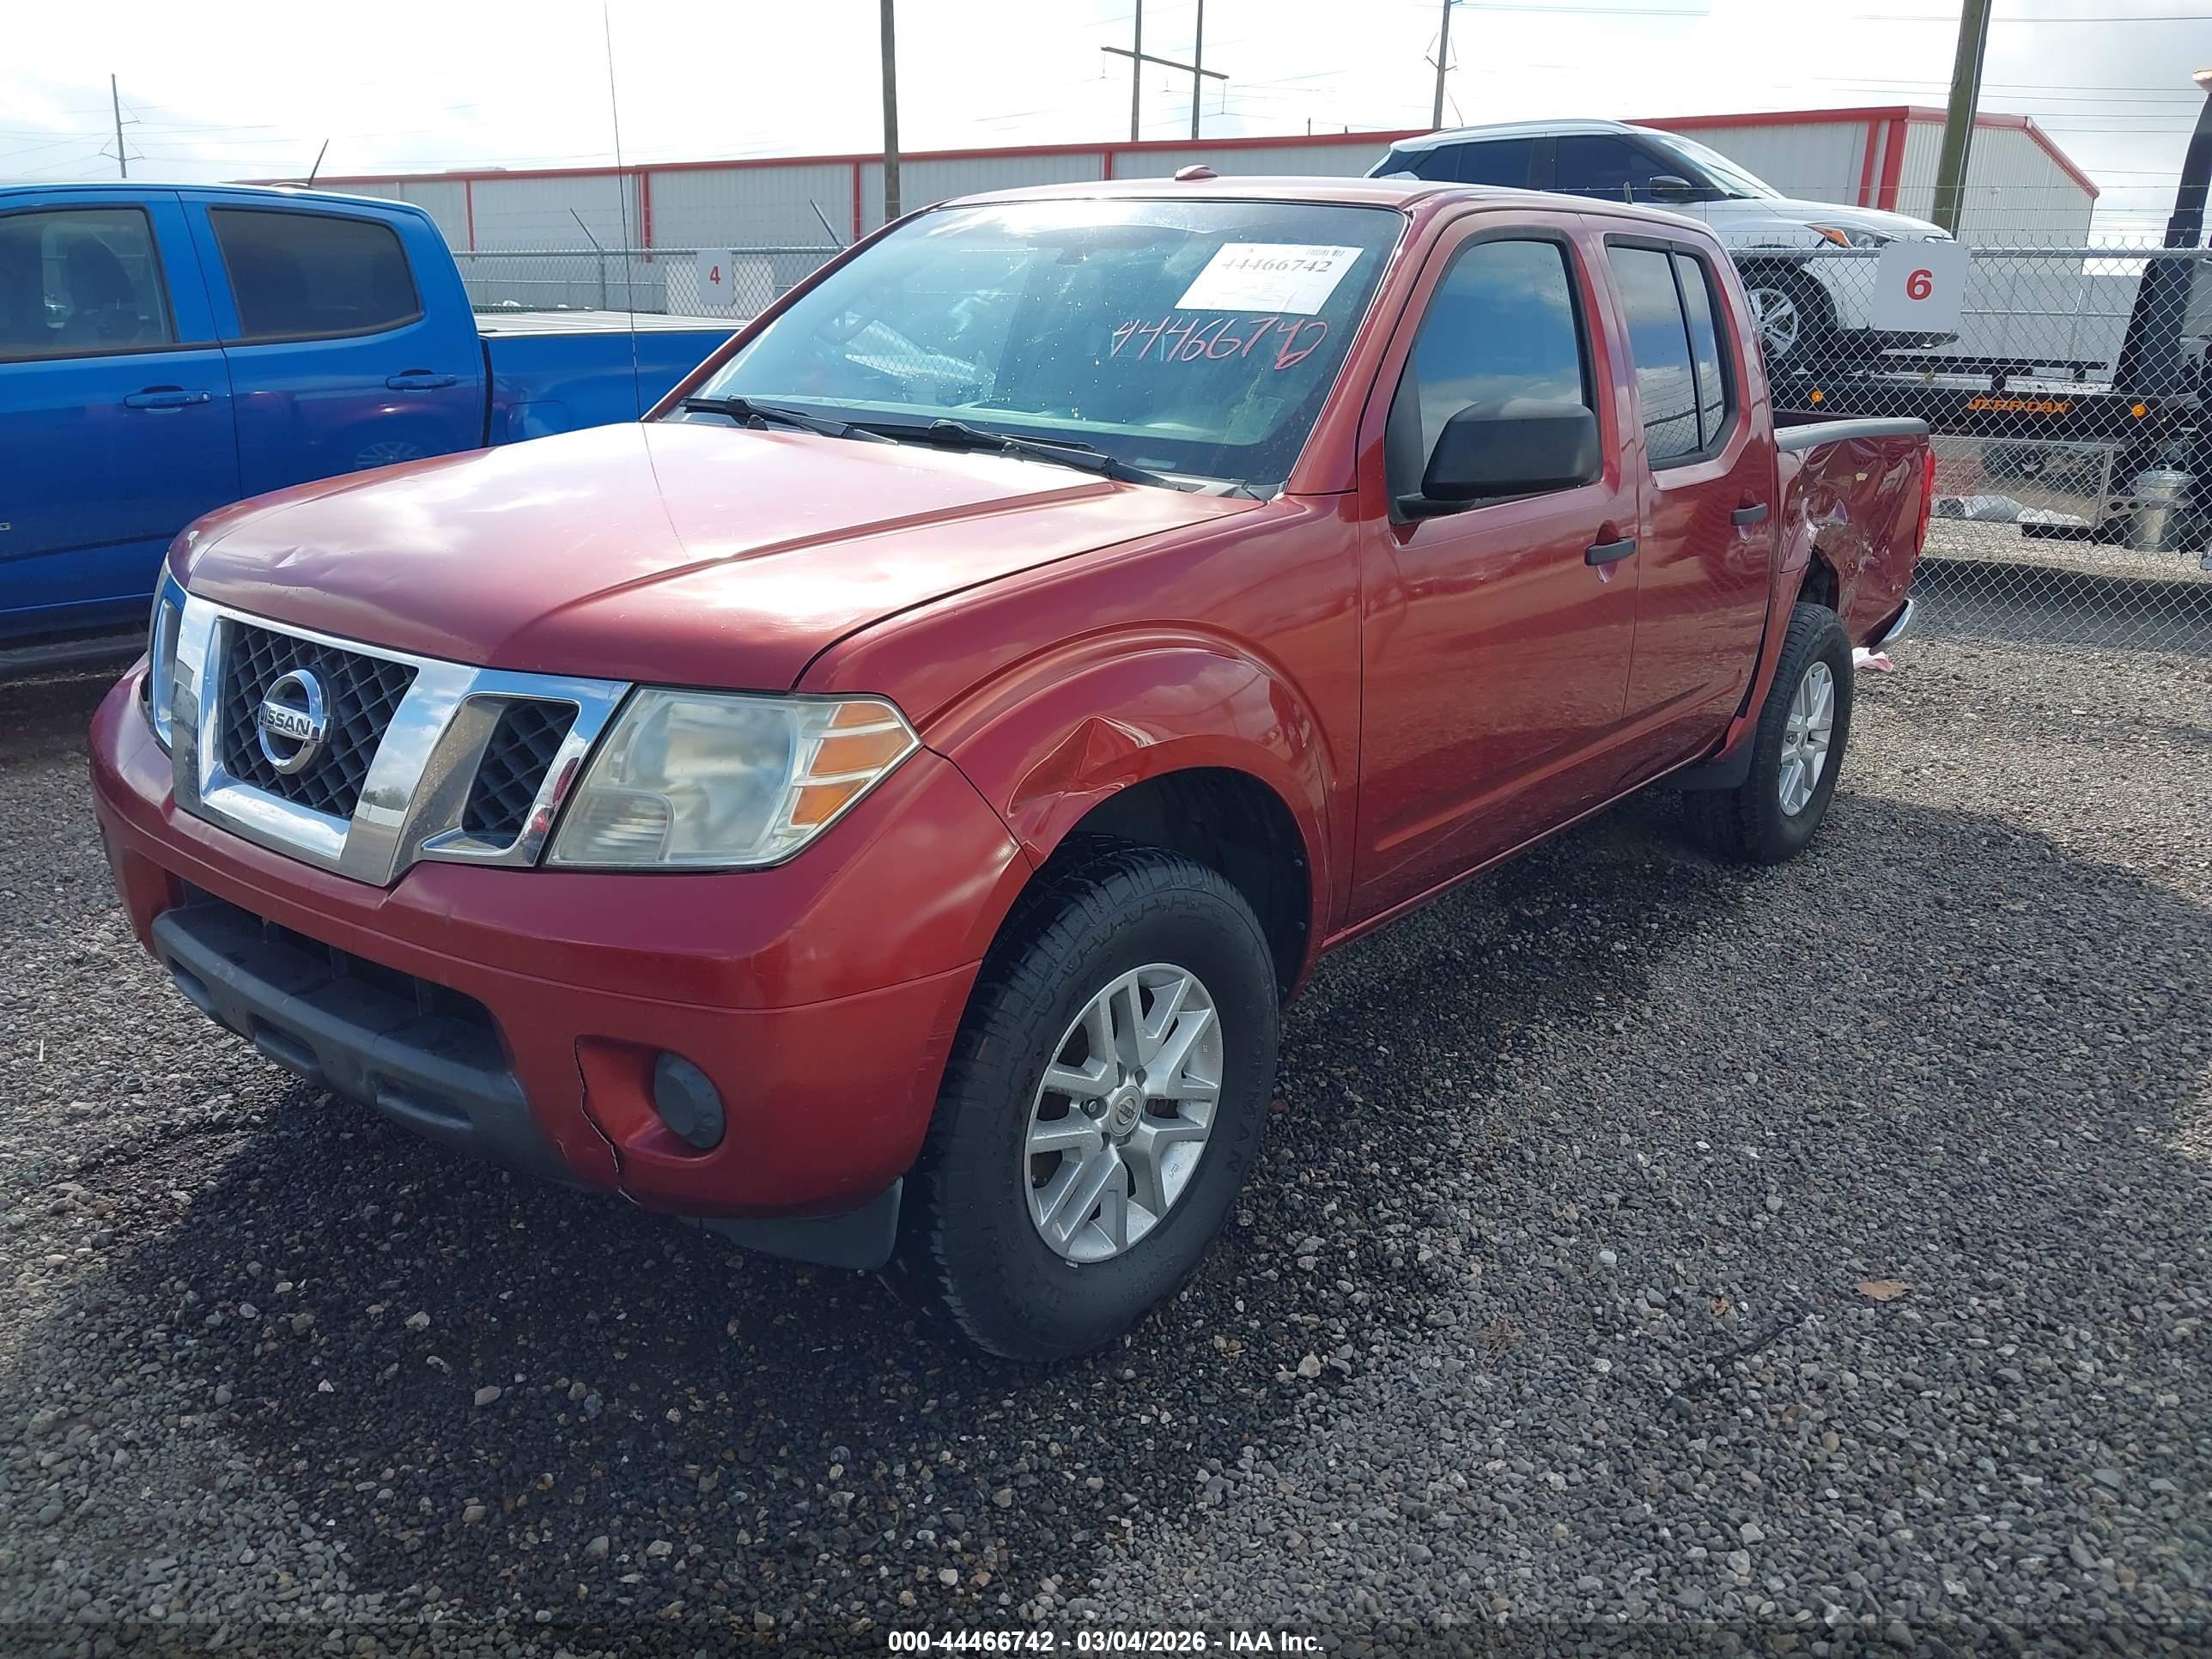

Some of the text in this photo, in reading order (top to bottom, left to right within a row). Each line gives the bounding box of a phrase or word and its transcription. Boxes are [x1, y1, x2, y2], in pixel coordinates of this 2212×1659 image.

[709, 265, 721, 284] 4
[1222, 258, 1333, 272] 44466742
[1906, 269, 1933, 301] 6
[1111, 316, 1328, 370] 44466742
[260, 706, 310, 736] NISSAN
